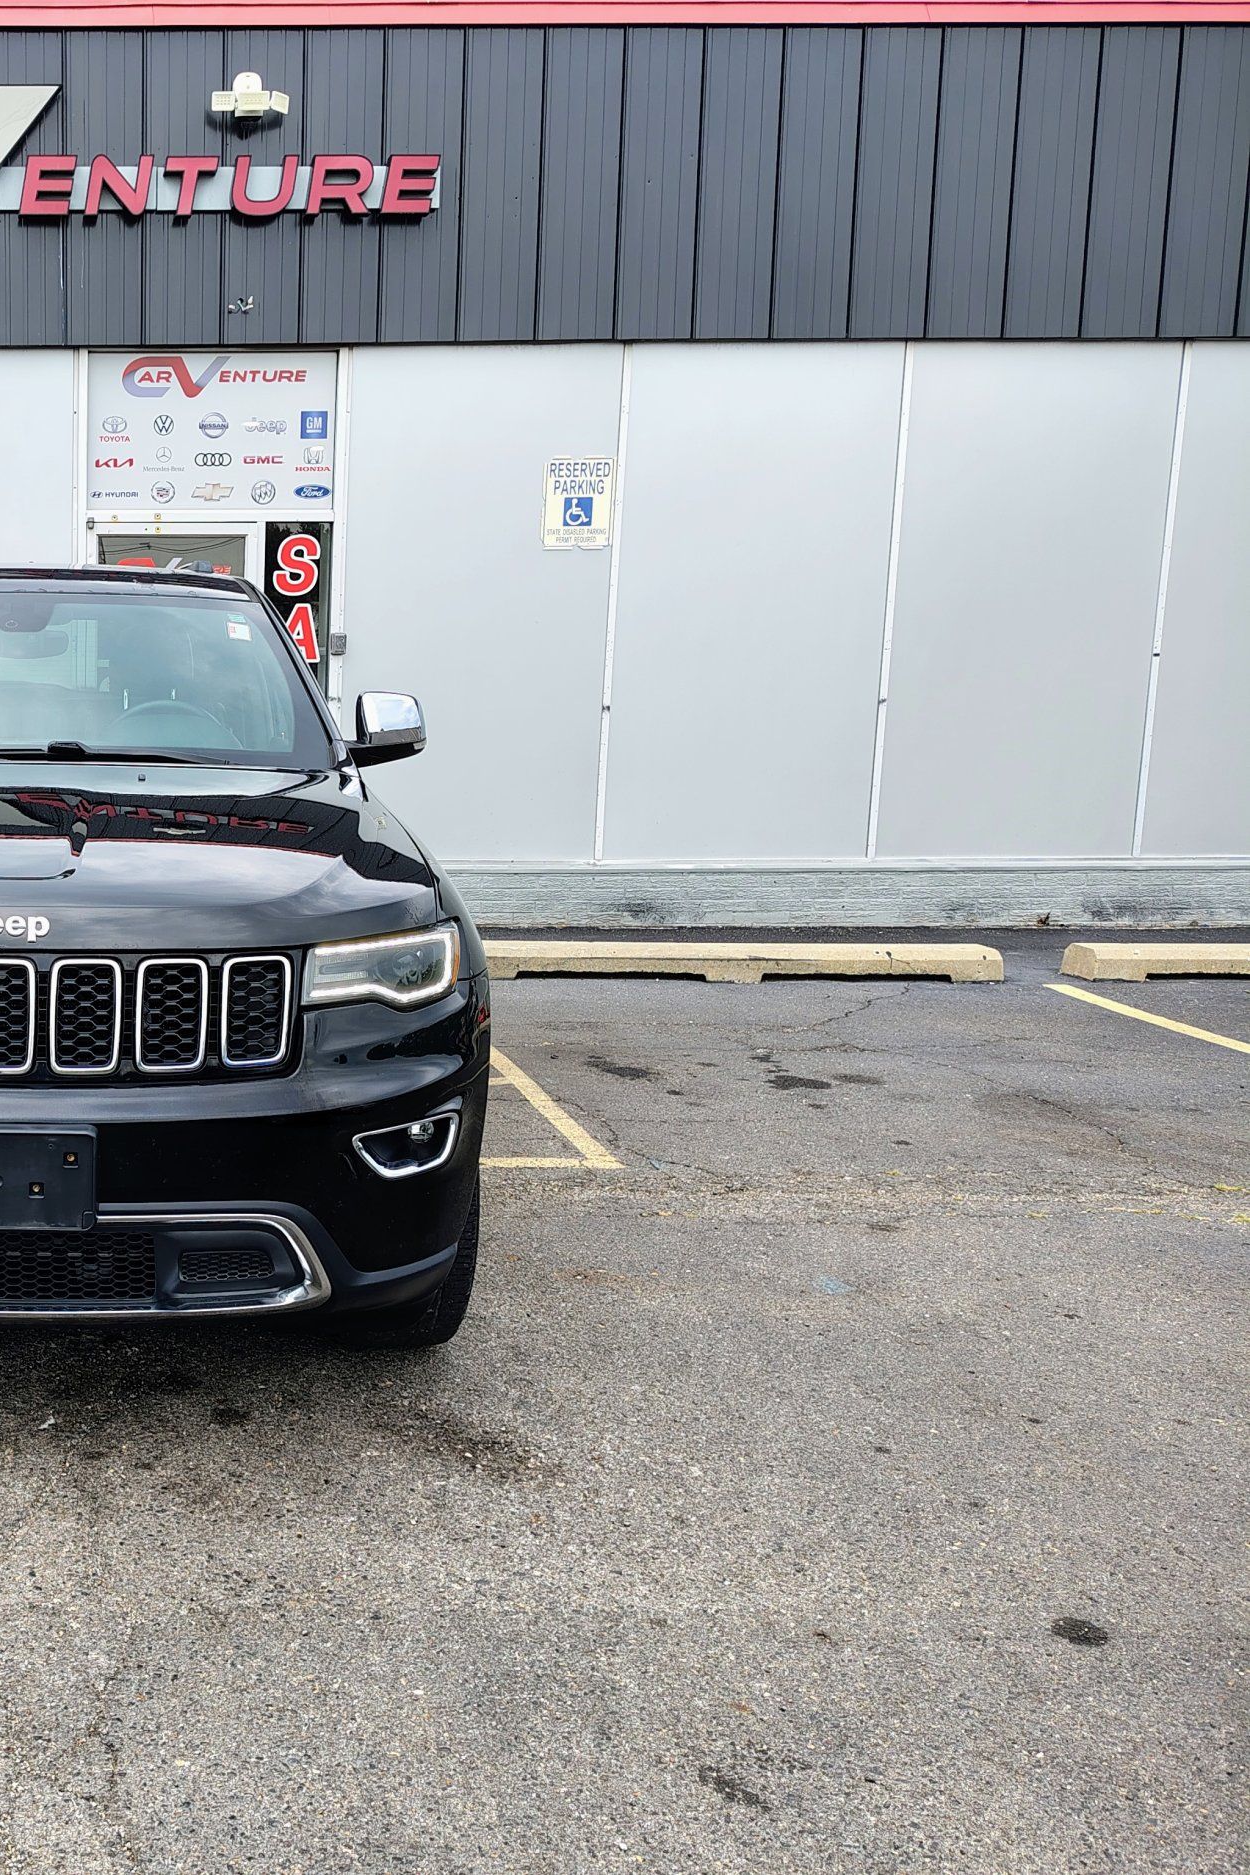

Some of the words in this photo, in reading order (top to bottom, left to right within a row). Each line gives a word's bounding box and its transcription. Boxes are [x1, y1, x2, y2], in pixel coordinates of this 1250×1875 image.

[306, 417, 323, 427] GM
[95, 458, 134, 468] KIA
[243, 456, 284, 464] GMC
[549, 462, 611, 478] RESERVED
[301, 487, 324, 497] Ford
[553, 479, 605, 495] PARKING
